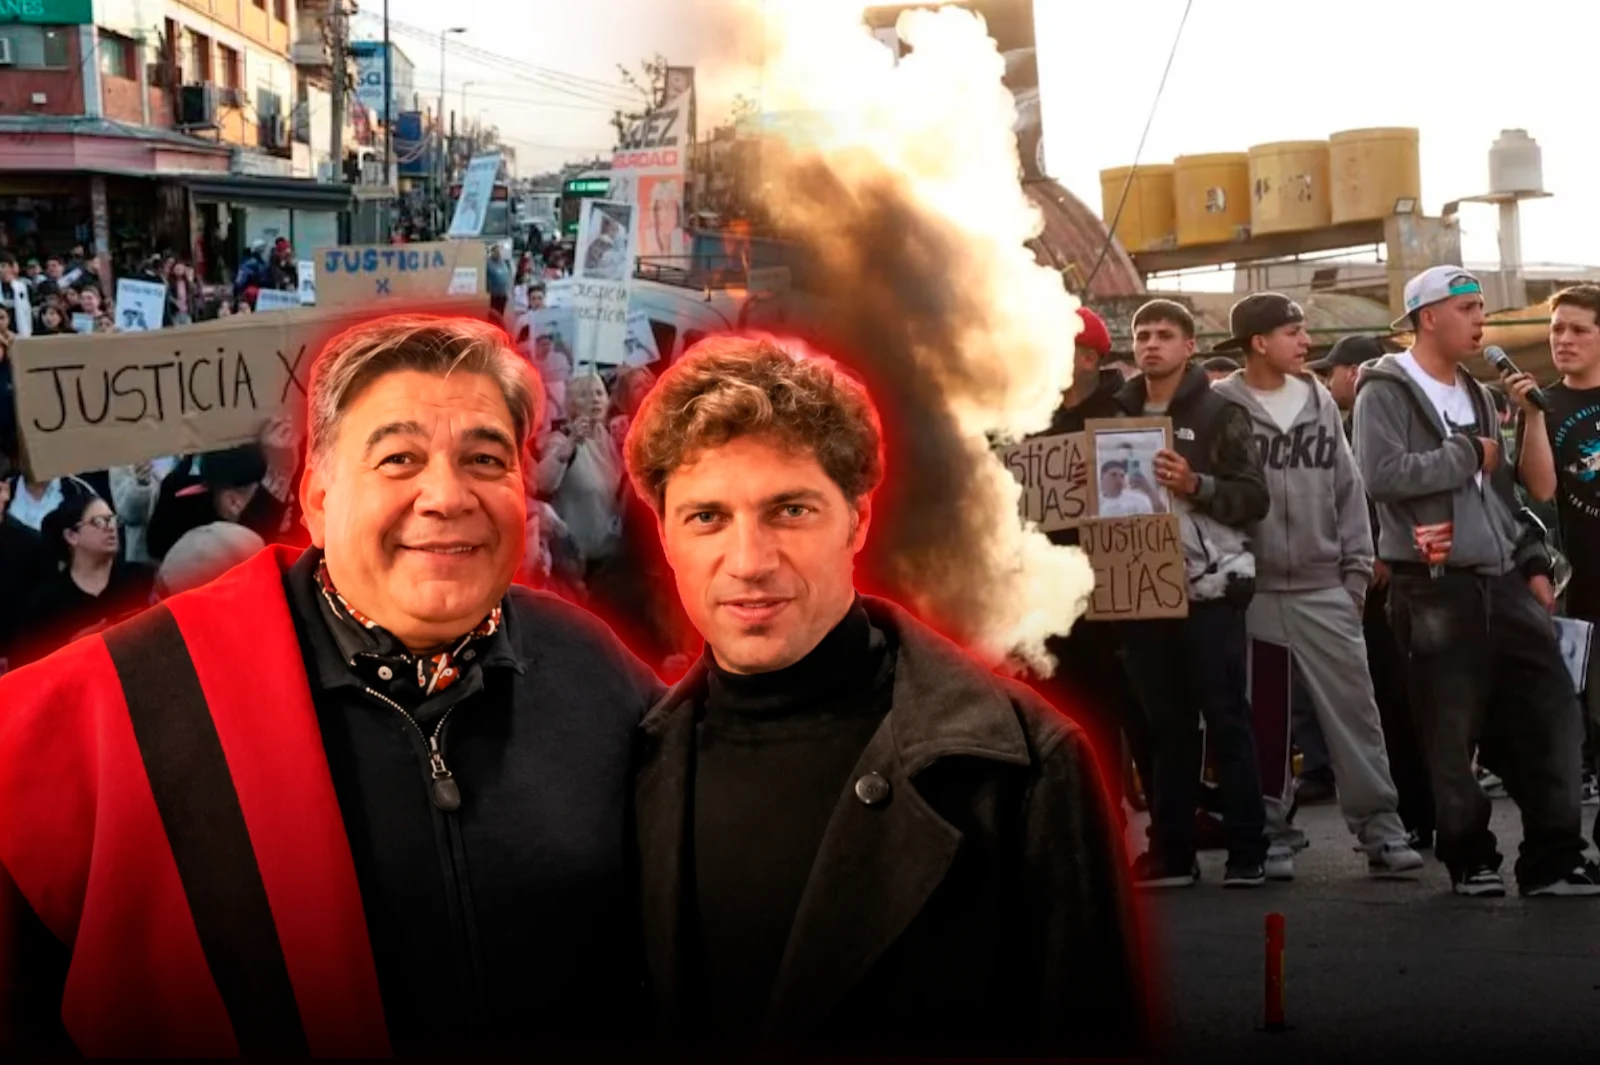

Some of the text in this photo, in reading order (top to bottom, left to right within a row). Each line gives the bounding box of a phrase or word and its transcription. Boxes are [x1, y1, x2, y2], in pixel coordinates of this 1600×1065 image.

[325, 248, 445, 273] JUSTICIA
[26, 346, 258, 433] JUSTICIA
[1081, 518, 1178, 555] JUSTICIA
